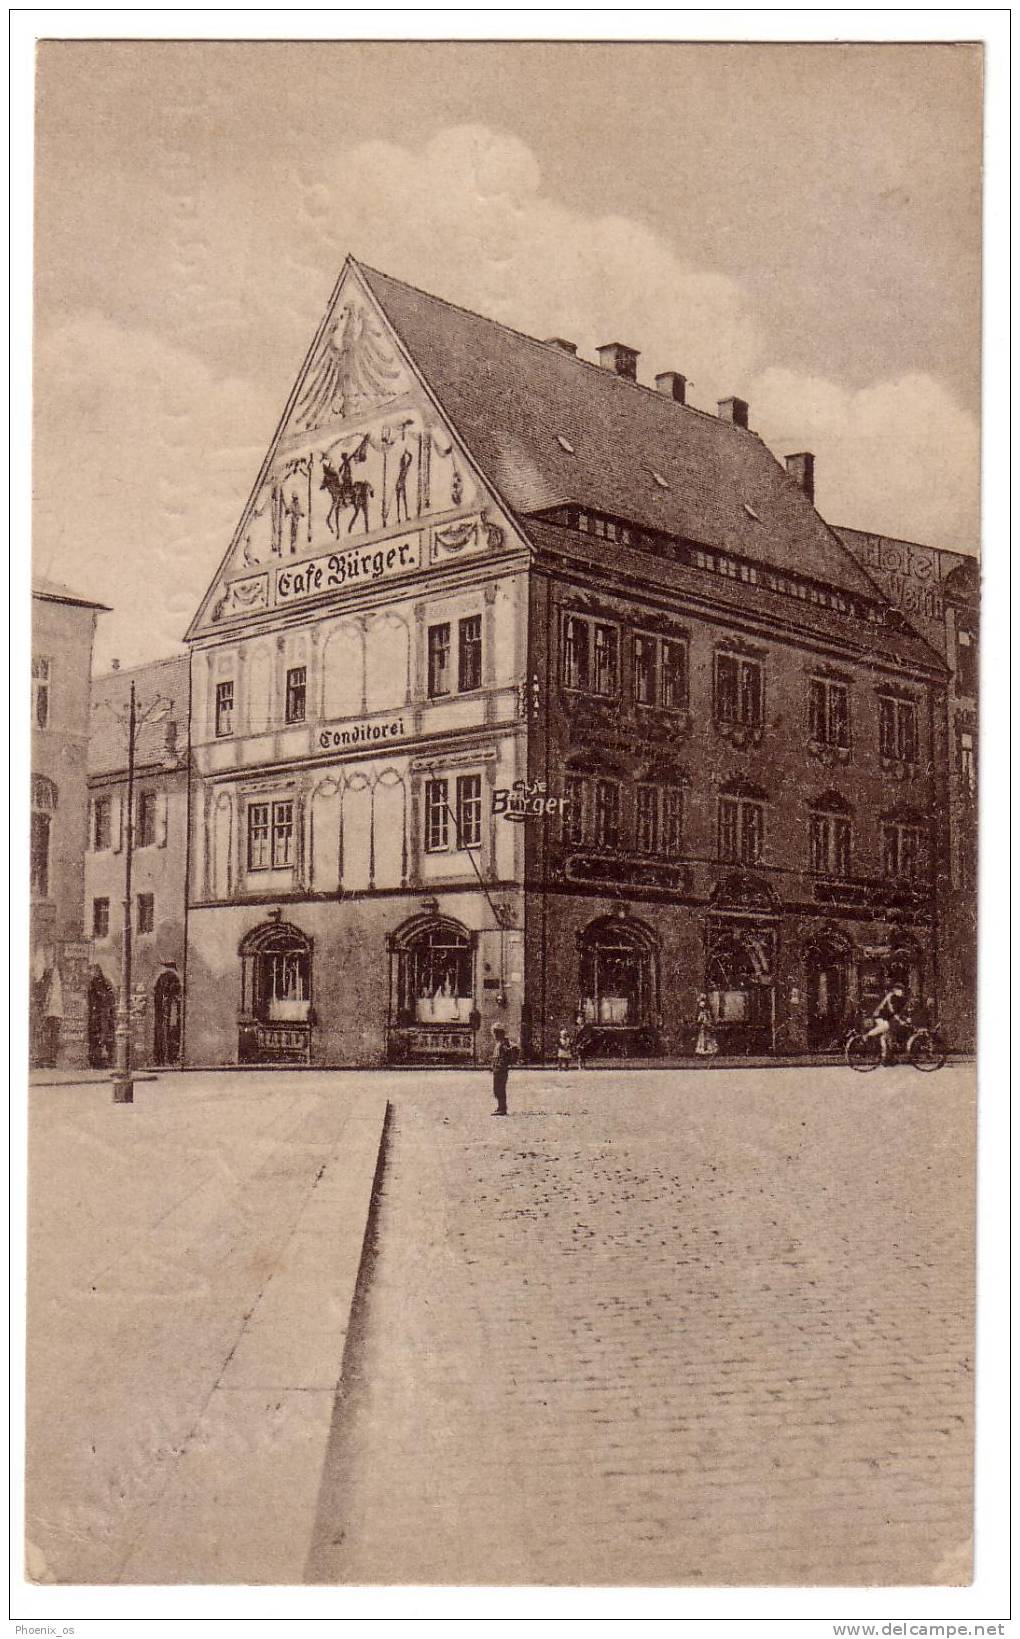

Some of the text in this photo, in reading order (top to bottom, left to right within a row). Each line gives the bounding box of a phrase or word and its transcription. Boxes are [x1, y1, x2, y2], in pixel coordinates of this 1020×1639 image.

[278, 544, 415, 597] Cafe Bürger.
[860, 536, 942, 583] Hotel
[319, 718, 404, 748] Conditorei
[492, 789, 570, 821] Bürger
